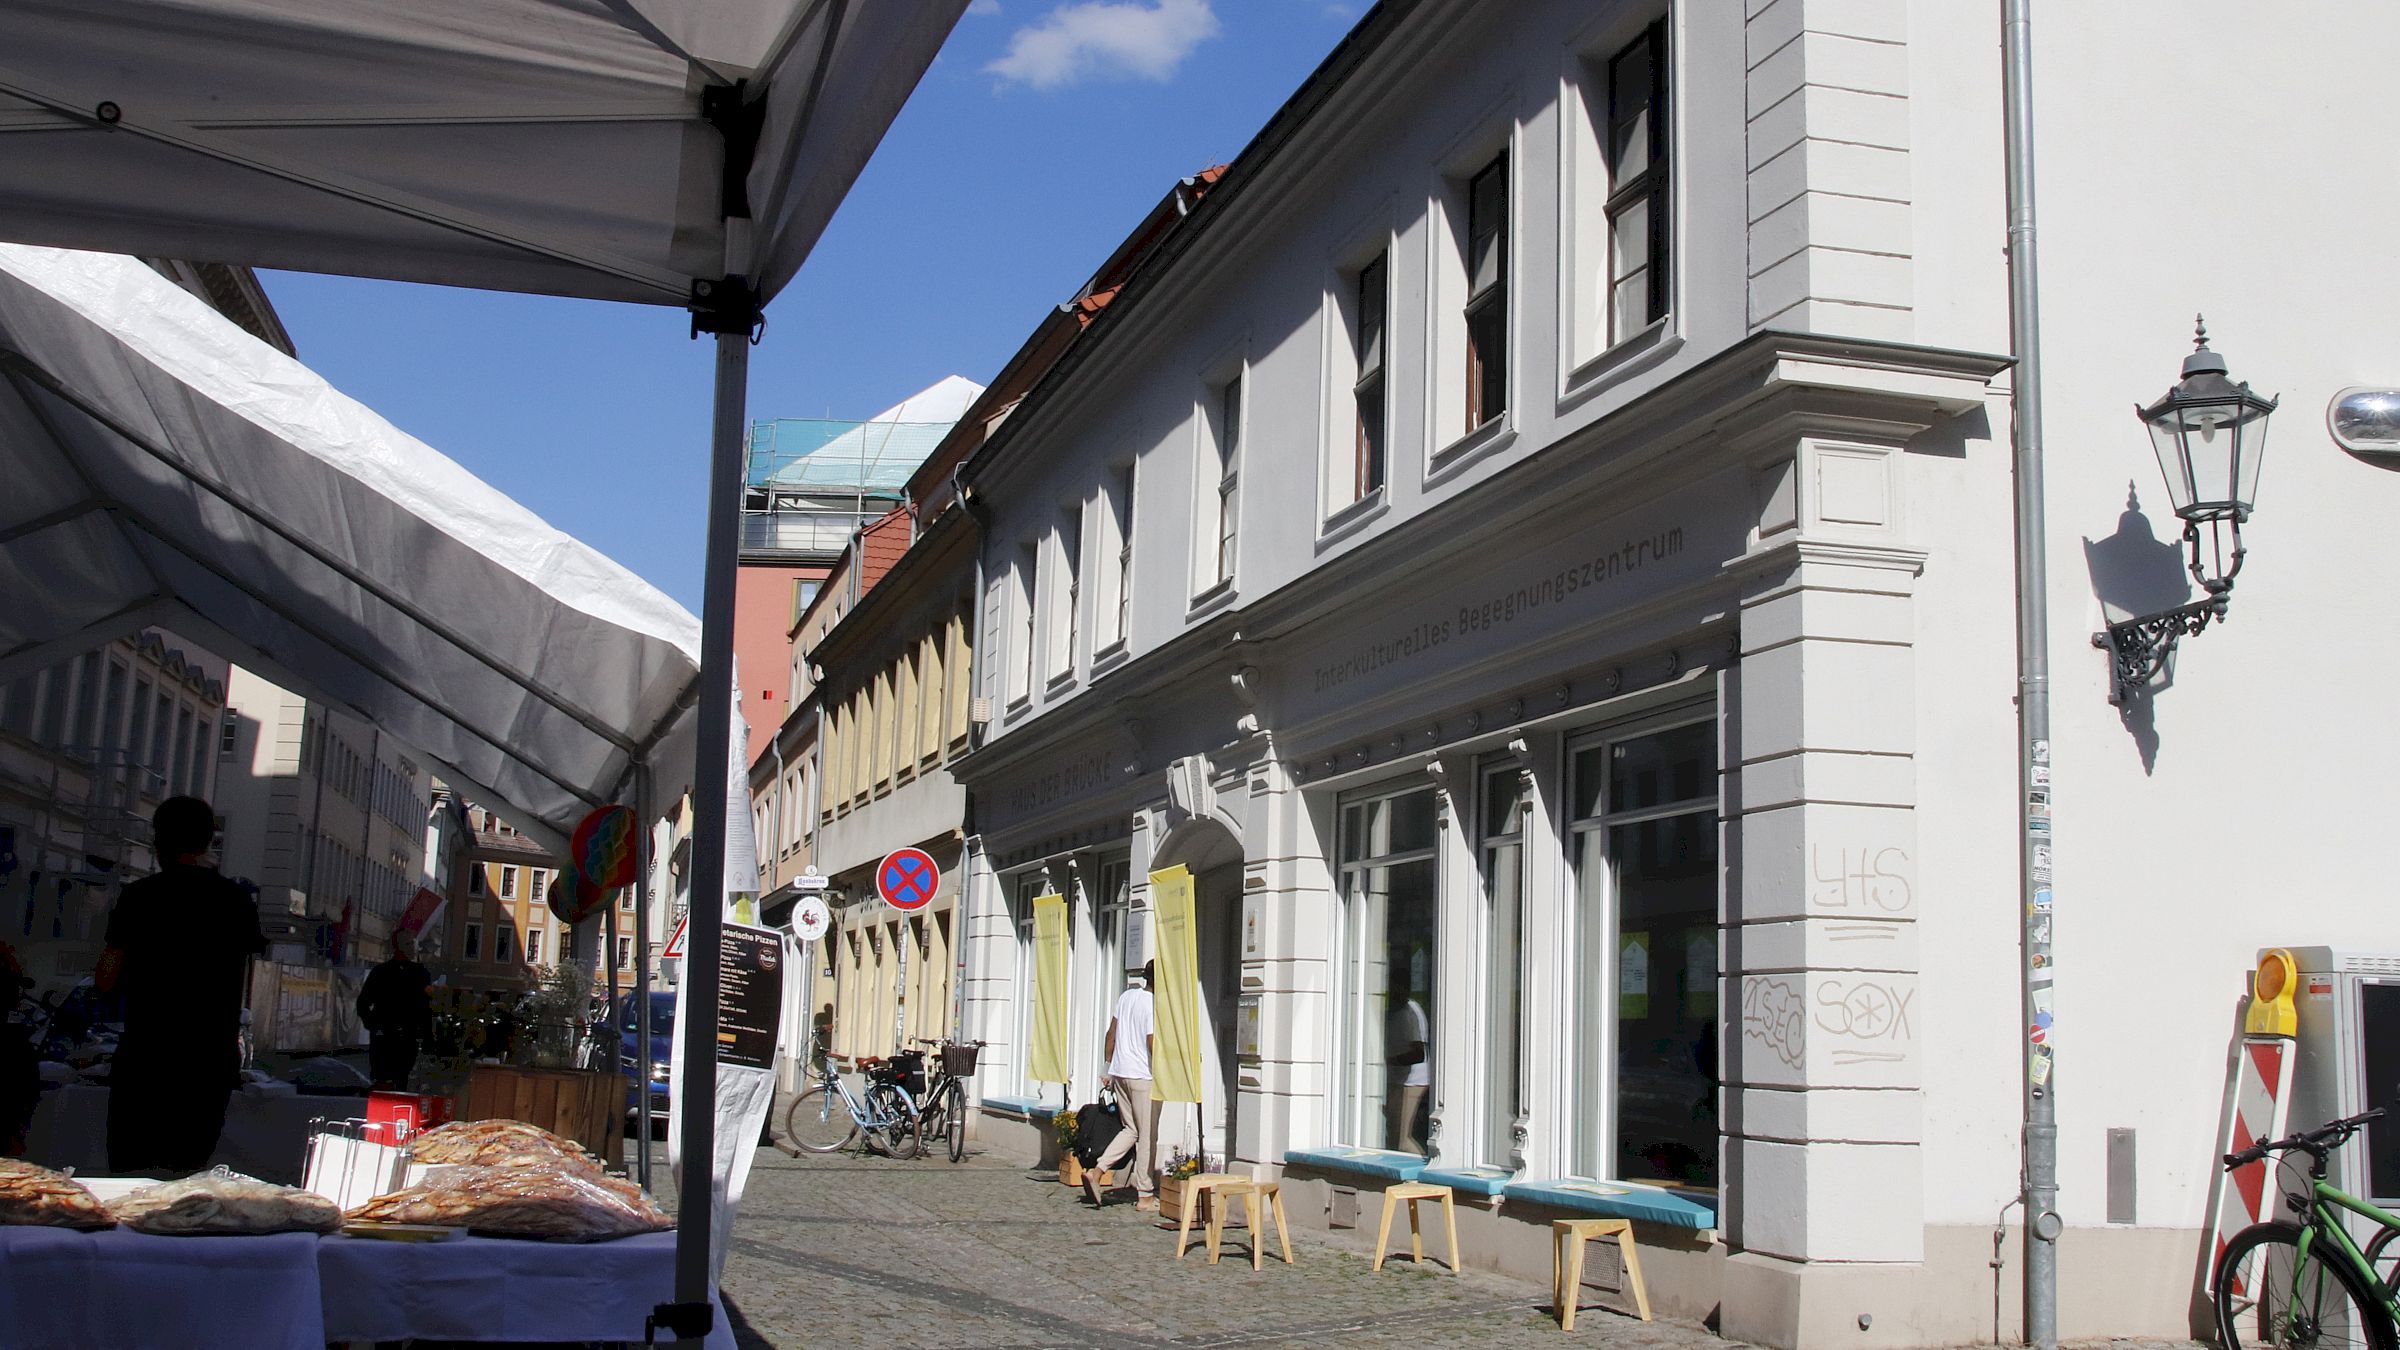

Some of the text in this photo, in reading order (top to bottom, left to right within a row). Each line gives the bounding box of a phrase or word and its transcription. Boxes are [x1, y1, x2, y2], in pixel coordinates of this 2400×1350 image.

[1314, 526, 1684, 693] Interkulturelles Begegnungszentrum
[1064, 751, 1112, 797] BRÜCKE
[721, 929, 778, 947] etarische Pizzen
